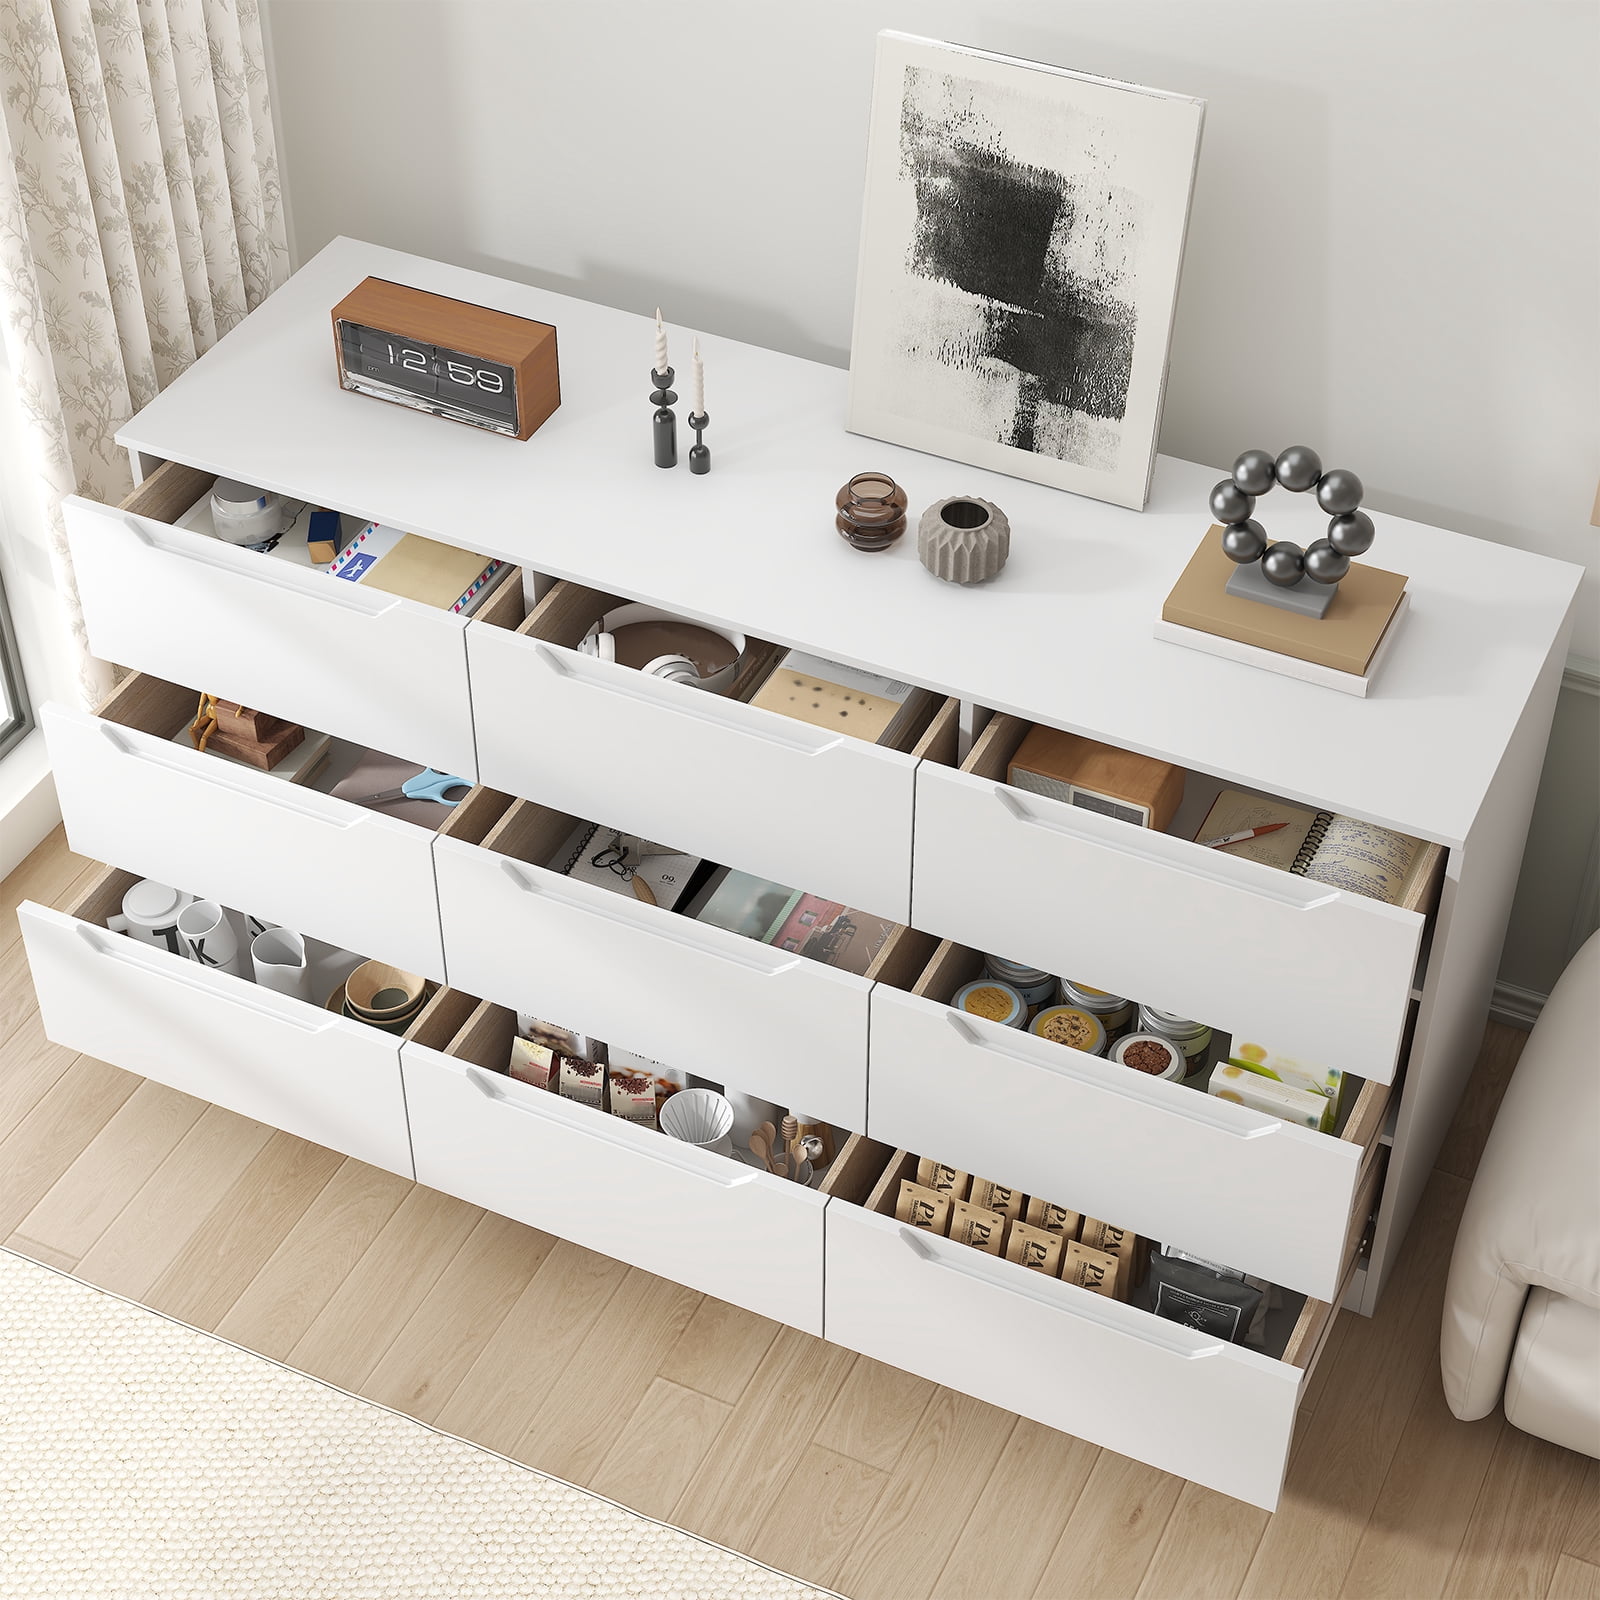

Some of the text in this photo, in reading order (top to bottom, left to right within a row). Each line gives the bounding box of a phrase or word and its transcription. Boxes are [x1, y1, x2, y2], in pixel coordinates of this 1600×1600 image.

[447, 361, 503, 394] 59
[188, 938, 219, 965] K
[937, 1164, 957, 1194] PA
